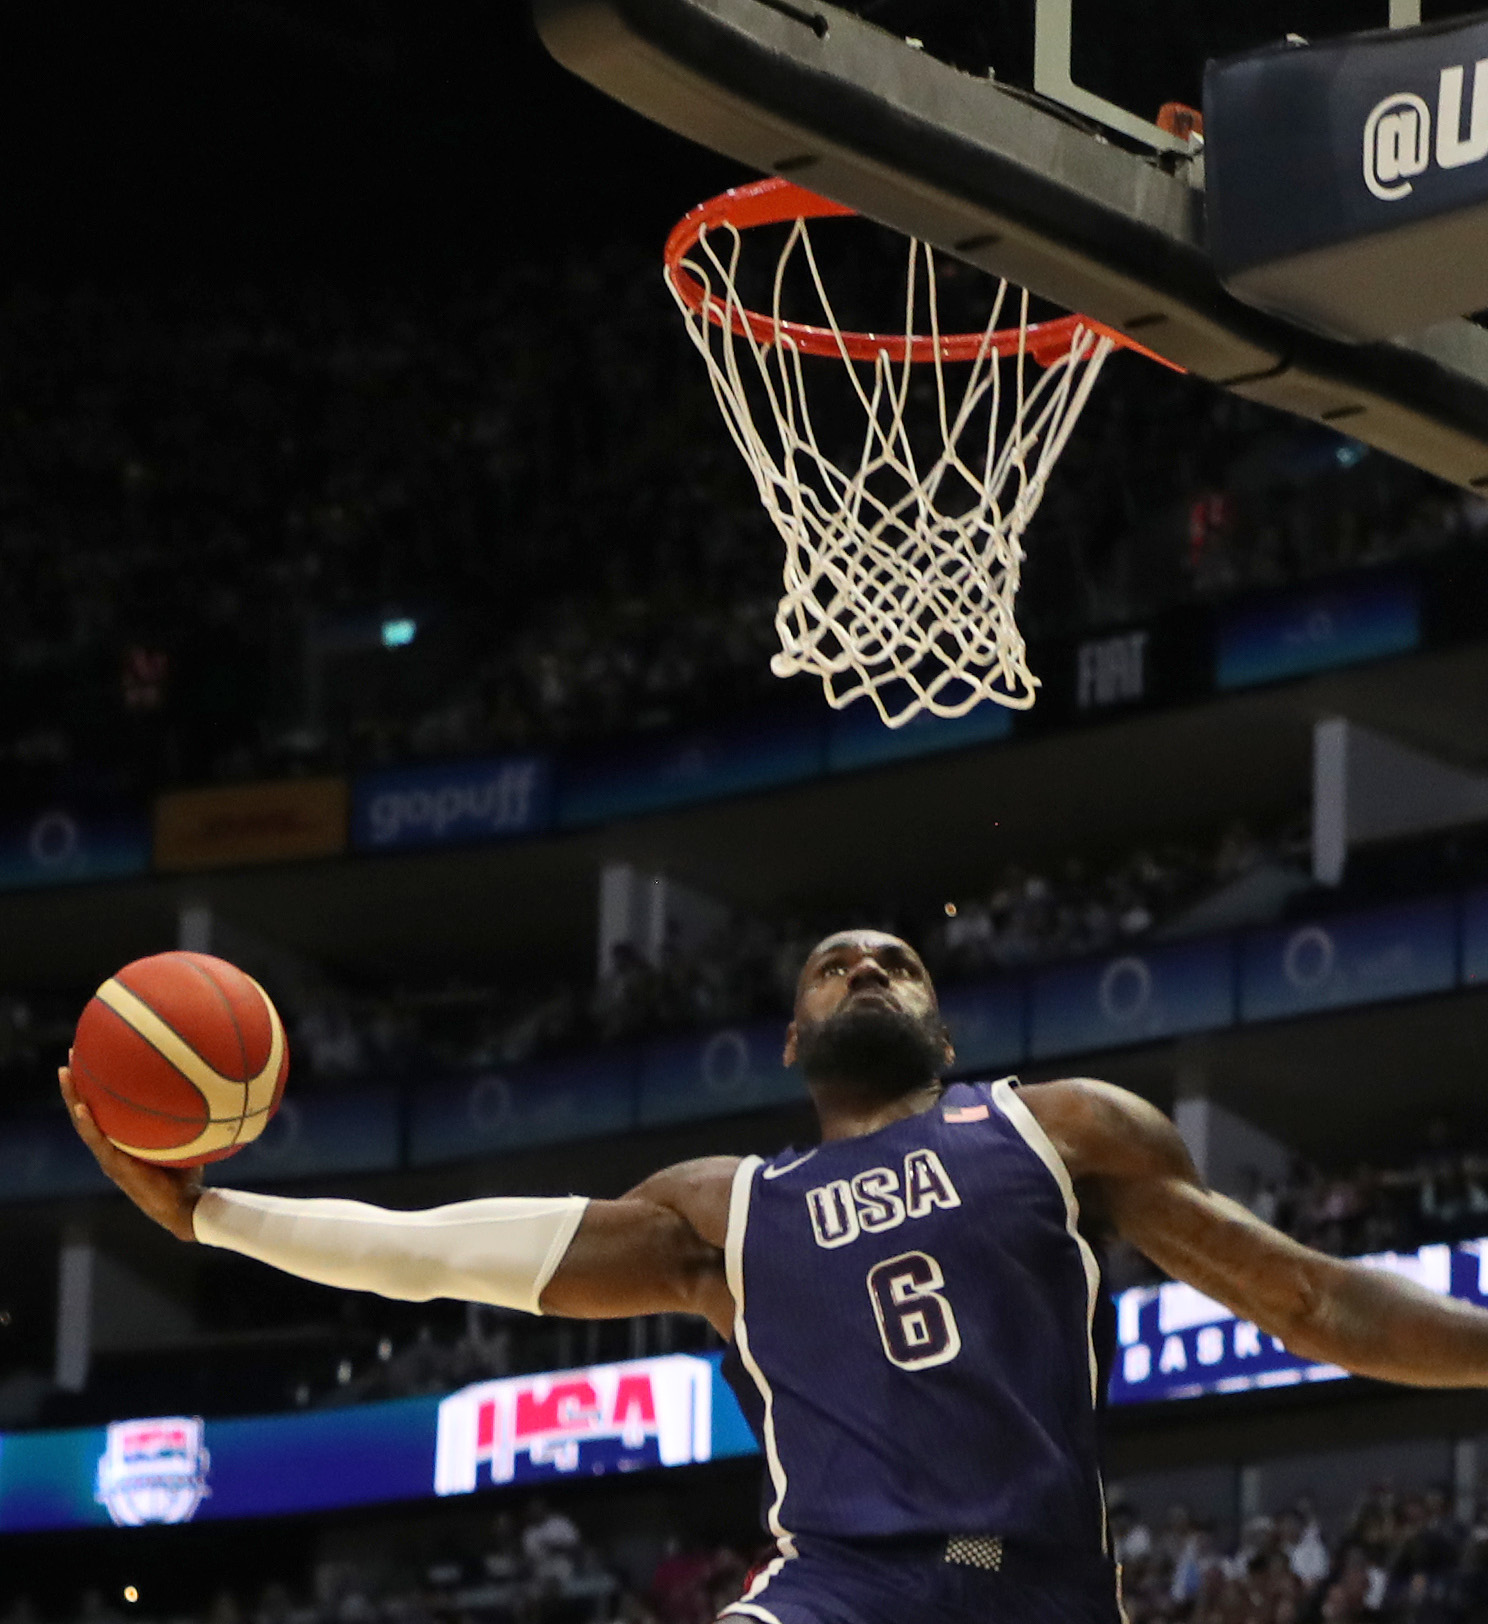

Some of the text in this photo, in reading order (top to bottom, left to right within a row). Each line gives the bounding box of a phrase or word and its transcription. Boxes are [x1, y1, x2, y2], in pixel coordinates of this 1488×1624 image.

[1078, 631, 1149, 708] FIAT
[369, 760, 535, 844] gopuff
[806, 1148, 962, 1249] USA
[866, 1250, 961, 1372] 6
